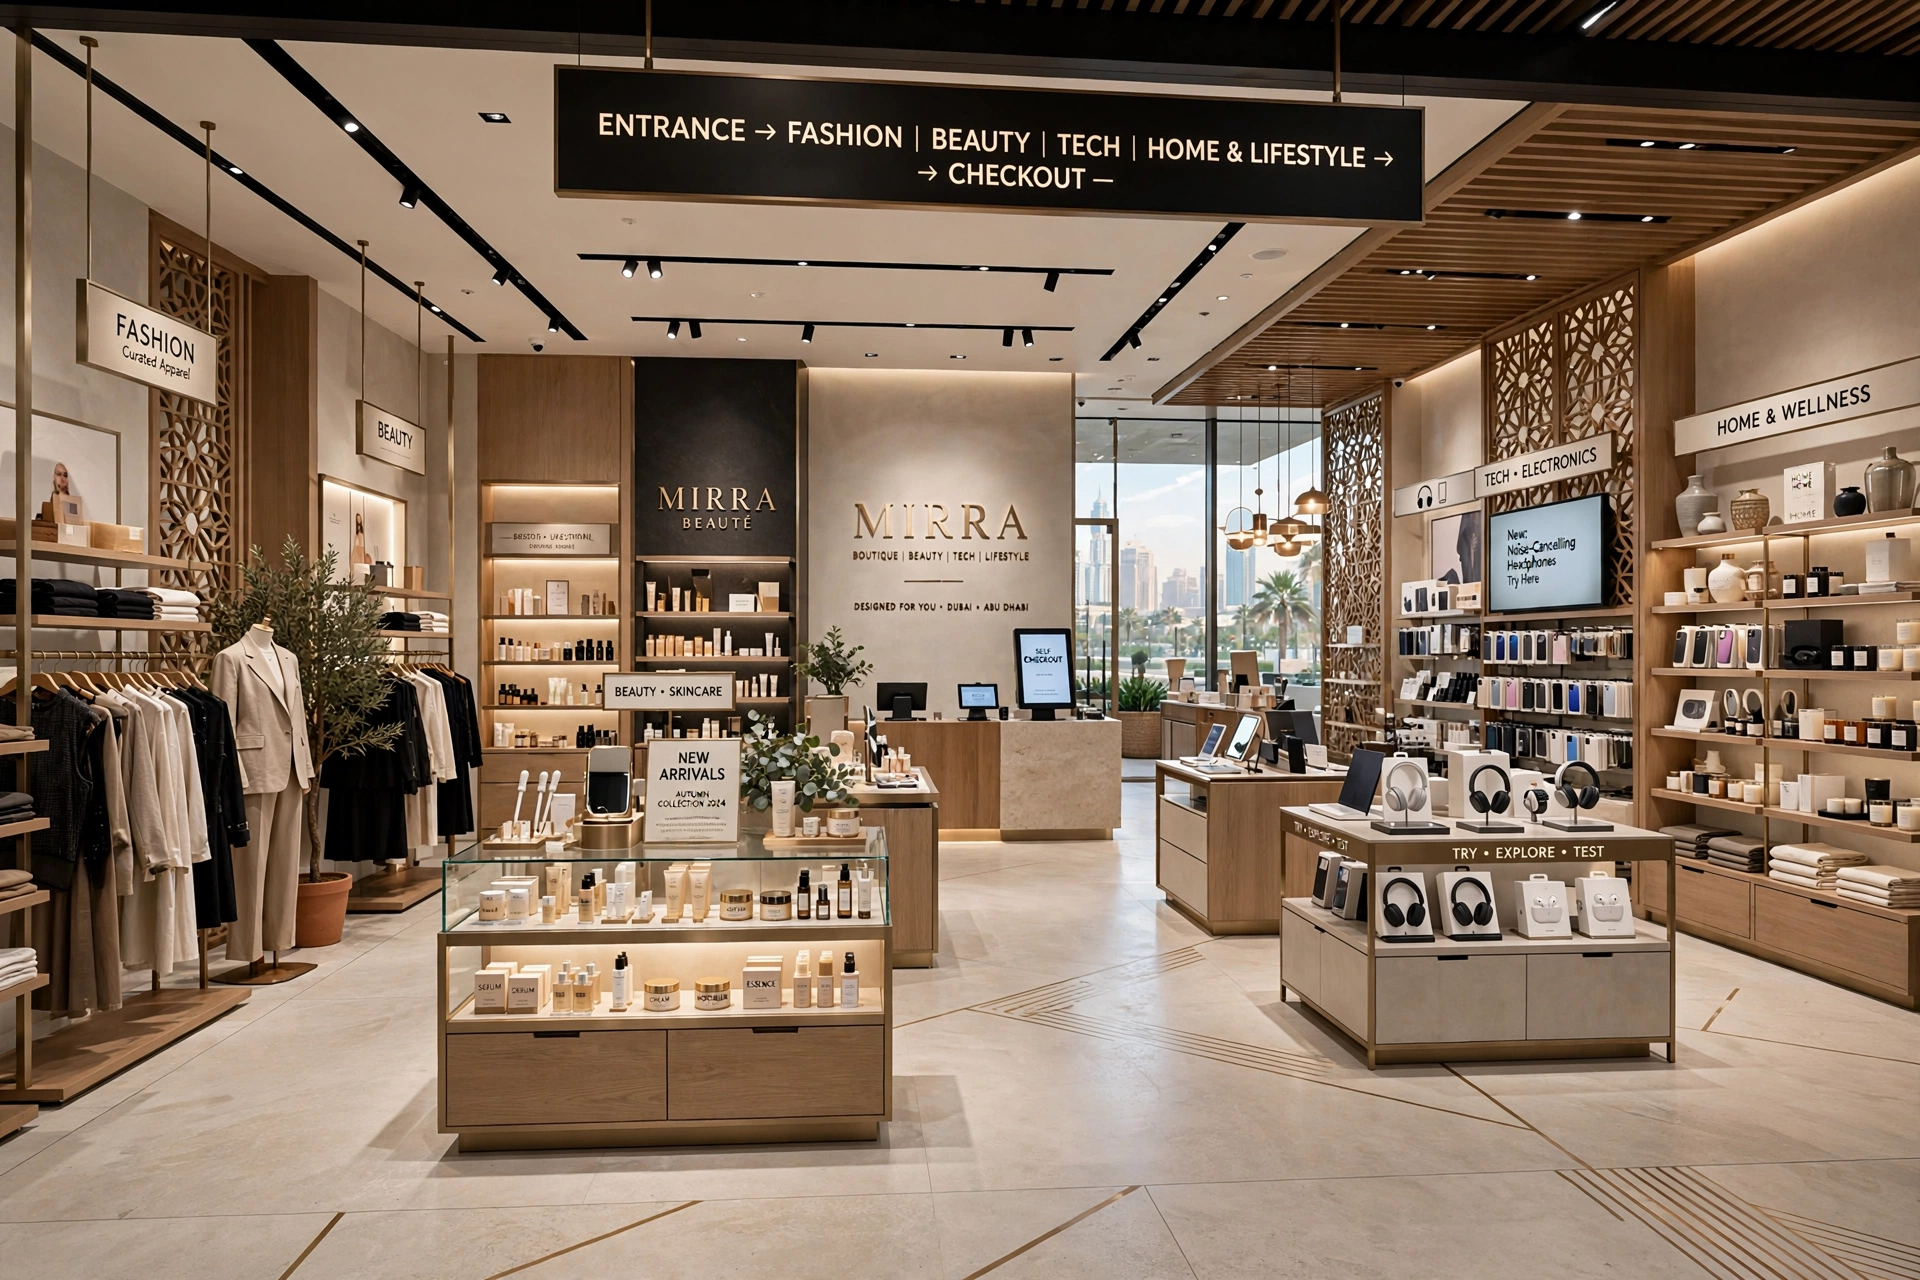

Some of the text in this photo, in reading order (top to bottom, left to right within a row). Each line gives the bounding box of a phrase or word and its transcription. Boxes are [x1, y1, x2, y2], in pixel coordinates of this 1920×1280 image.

[597, 112, 1366, 168] ENTRANCE FASHION BEAUTY TECH HOME & LIFESTYLE
[949, 163, 1085, 189] CHECKOUT
[117, 313, 194, 364] FASHION
[122, 345, 191, 380] Curated Apparel
[1717, 384, 1871, 437] HOME & WELLNESS
[377, 420, 413, 450] BEAUTY
[1484, 446, 1597, 488] TECH ELECTRONICS
[657, 486, 776, 512] MIRRA
[683, 514, 752, 530] BEAUTÉ
[853, 503, 1028, 540] MIRRA
[853, 551, 1029, 561] BOUTIQUE BEAUTY TECH LIFESTYLE
[1507, 573, 1540, 589] Try Here
[854, 602, 1029, 611] DESIGNED FOR YOU DUBAI ABU DHABI
[614, 686, 723, 697] BEAUTY SKINCARE
[678, 752, 710, 764] NEW
[659, 768, 725, 781] ARRIVALS
[1452, 845, 1605, 860] TRY EXPLORE TEST
